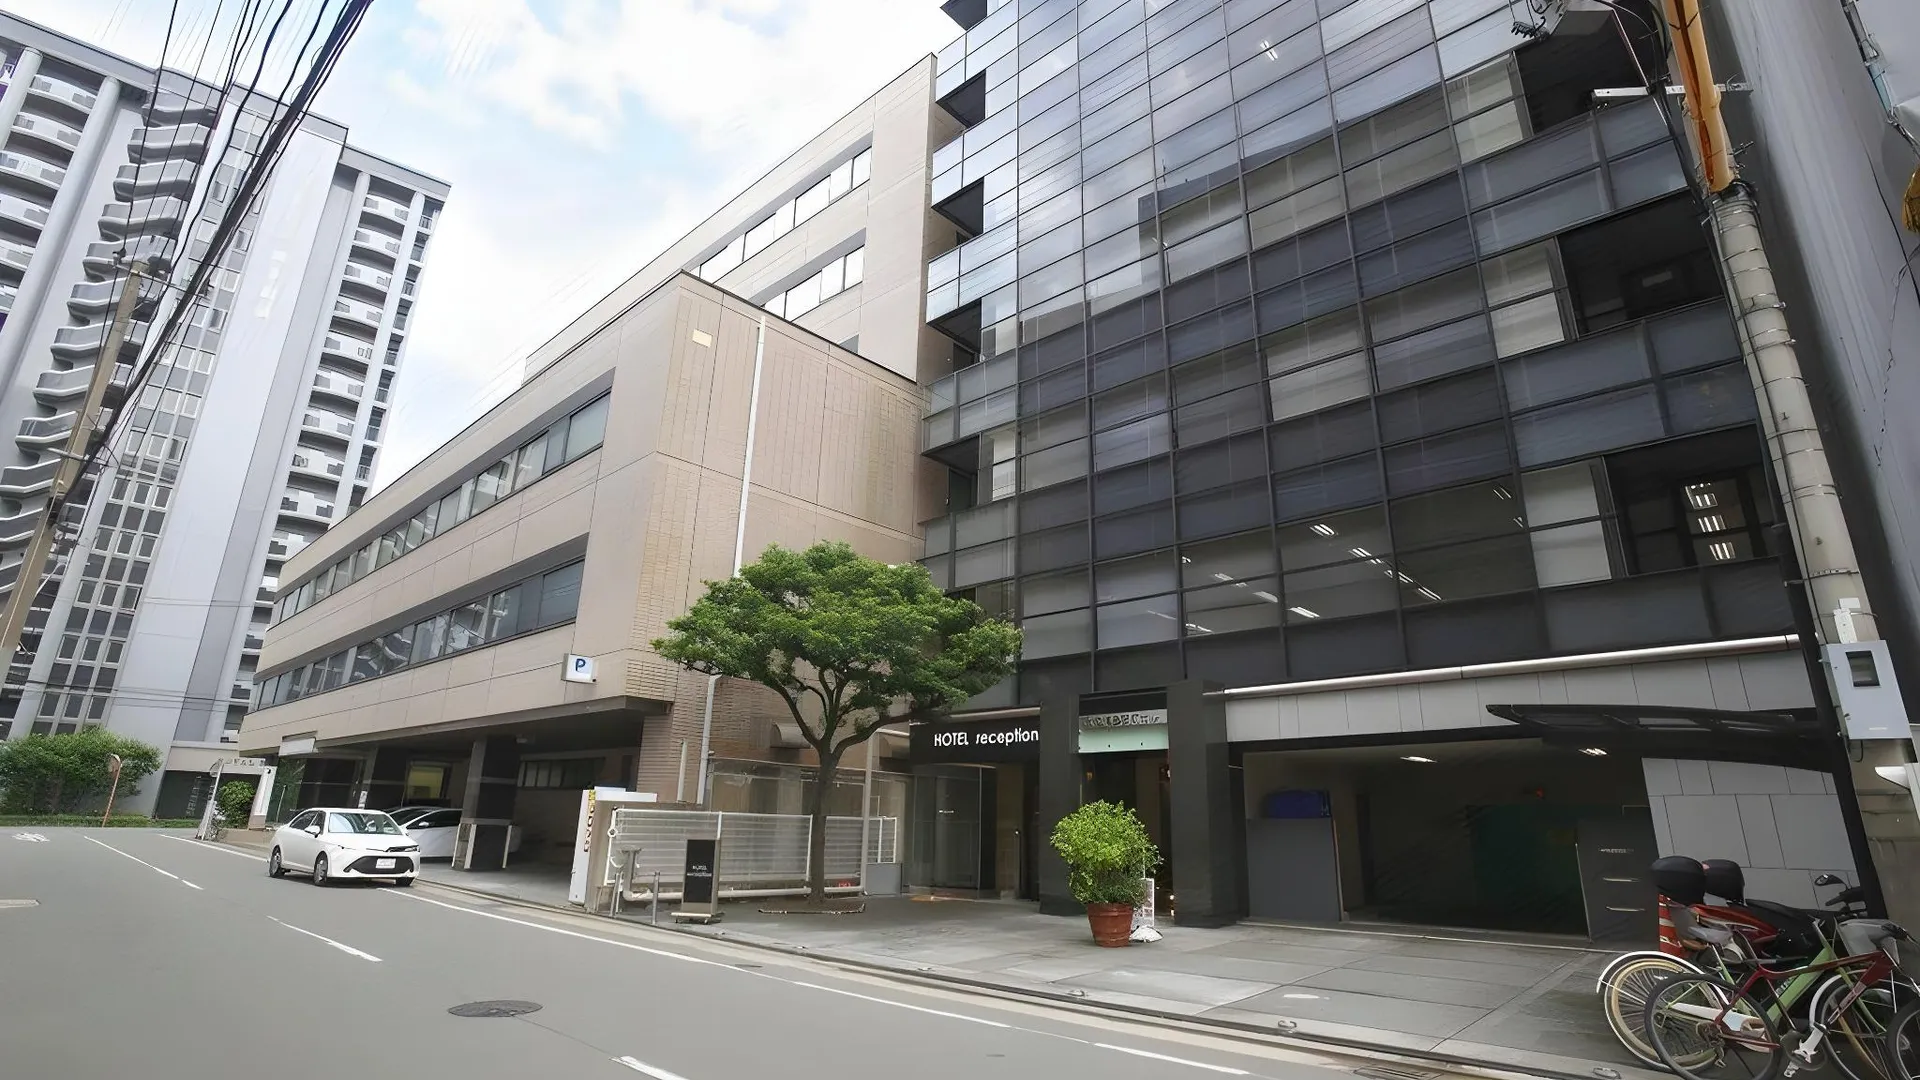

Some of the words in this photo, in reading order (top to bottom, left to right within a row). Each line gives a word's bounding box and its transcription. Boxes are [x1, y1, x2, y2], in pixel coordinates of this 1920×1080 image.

[575, 658, 586, 671] P
[934, 732, 969, 746] HOTEL
[976, 728, 1039, 746] reception
